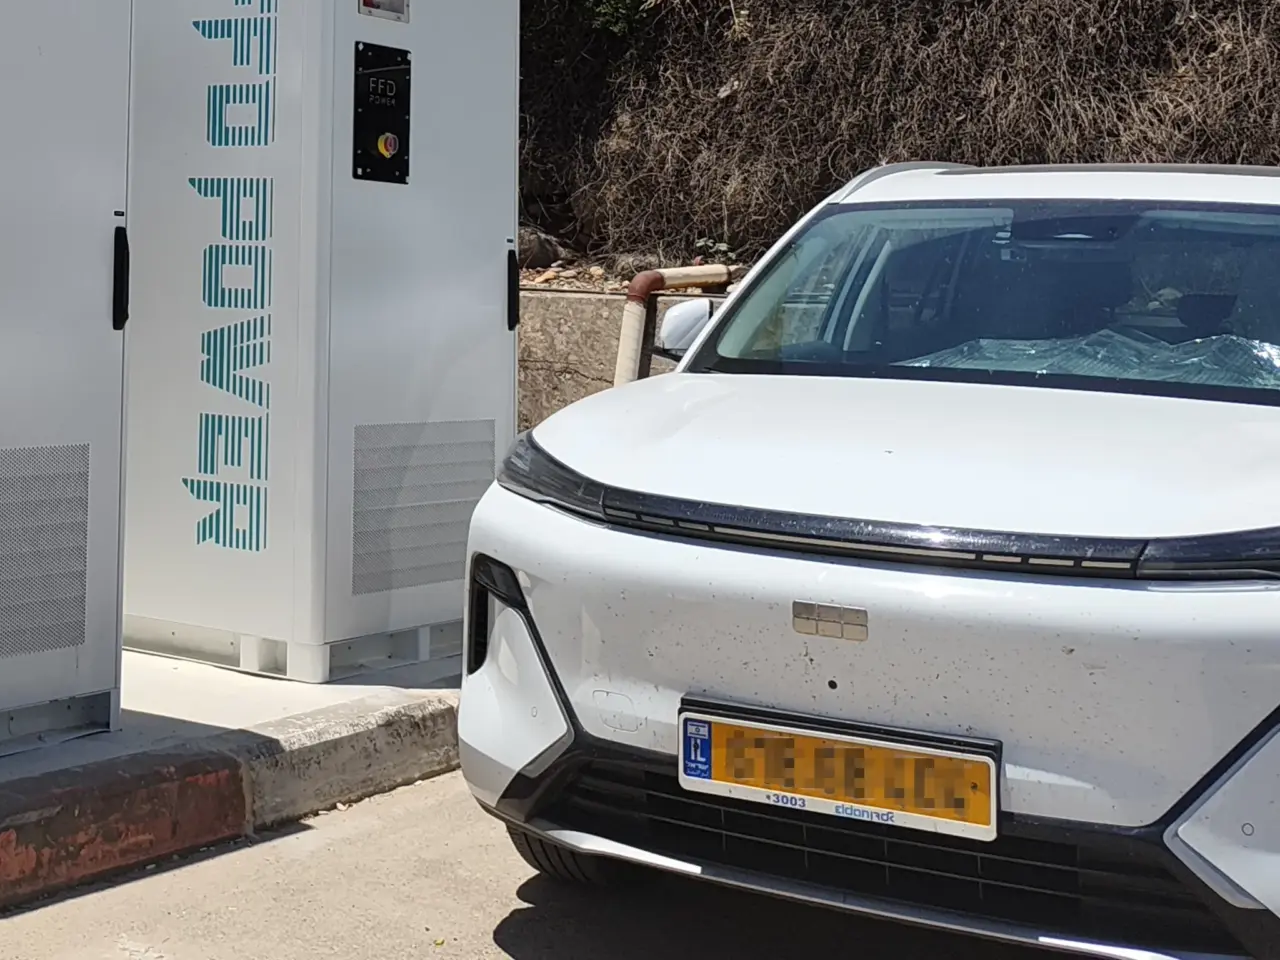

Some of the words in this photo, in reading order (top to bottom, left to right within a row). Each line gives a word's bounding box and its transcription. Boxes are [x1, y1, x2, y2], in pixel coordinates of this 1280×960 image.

[369, 77, 396, 96] FFD
[181, 177, 274, 552] POWER
[690, 737, 707, 762] IL
